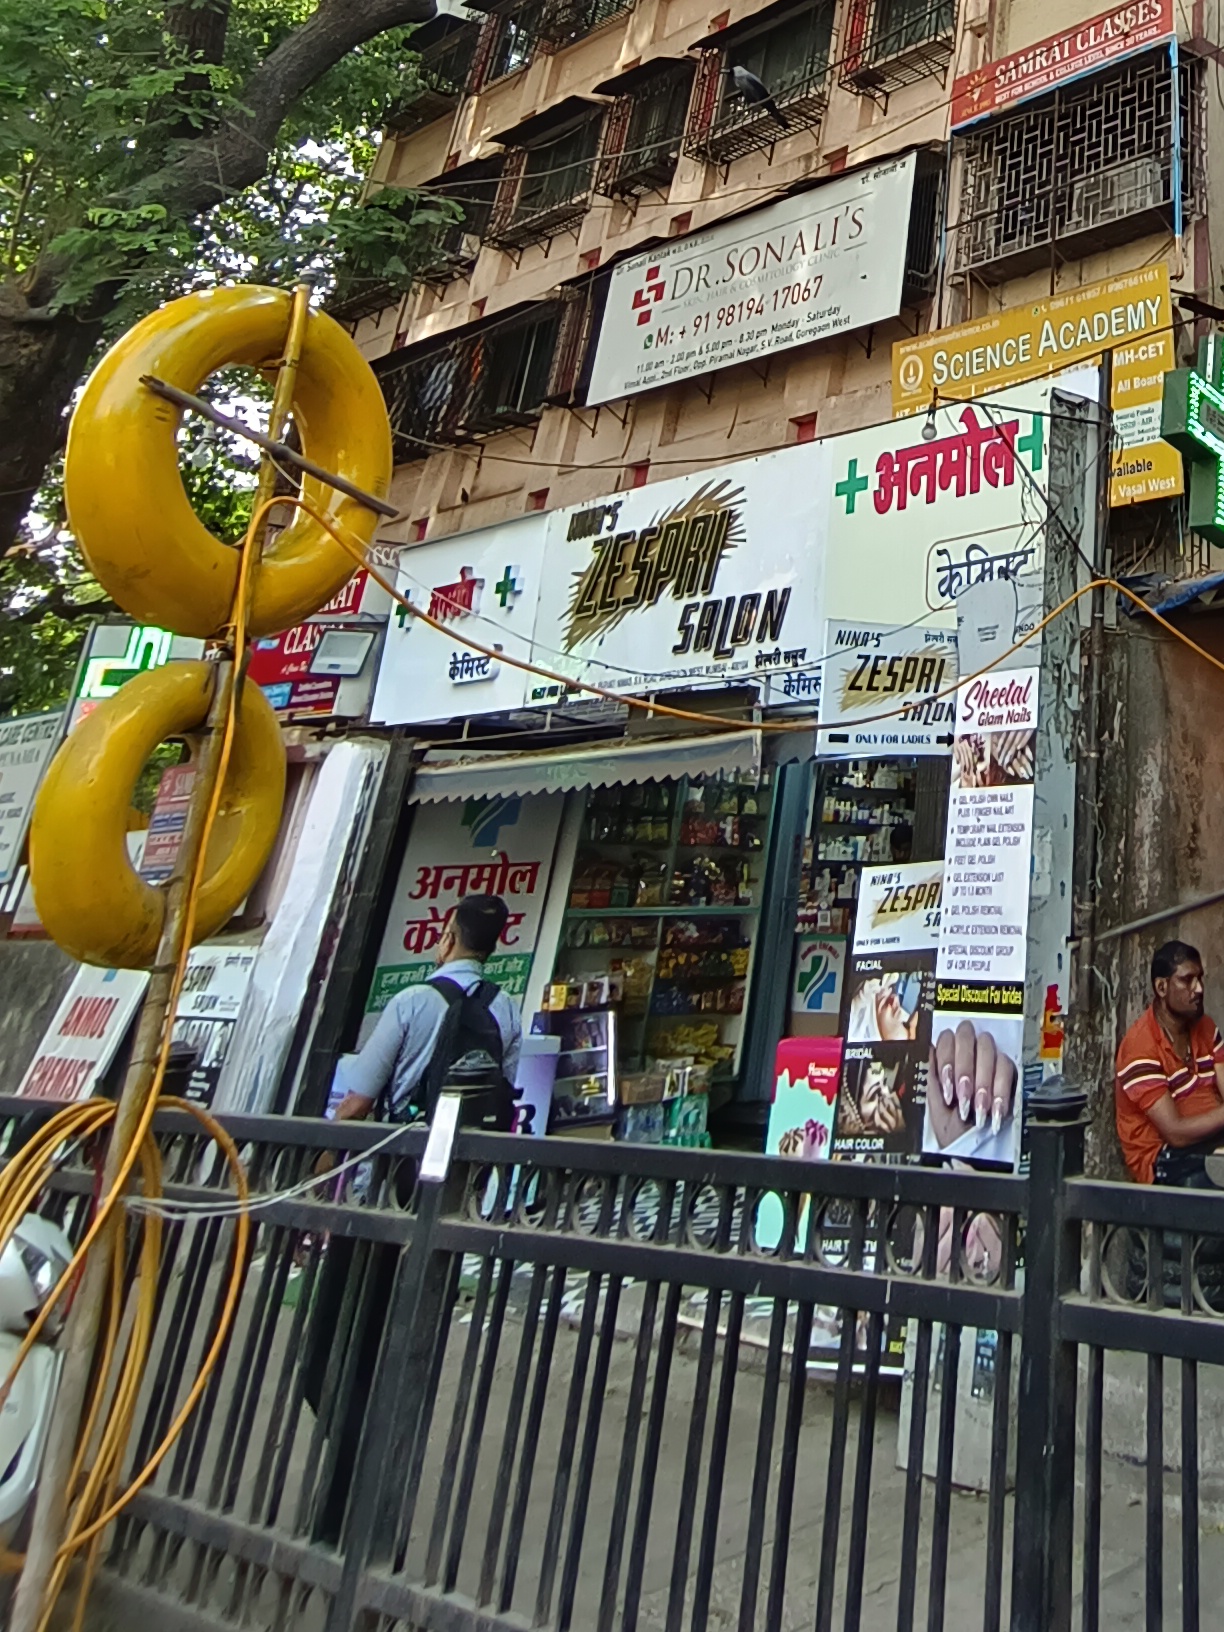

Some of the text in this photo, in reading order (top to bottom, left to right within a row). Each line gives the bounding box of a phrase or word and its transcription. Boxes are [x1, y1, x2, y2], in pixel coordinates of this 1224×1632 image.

[995, 35, 1075, 89] SAMRAT
[693, 311, 710, 337] 91
[717, 293, 765, 330] 98194
[772, 273, 824, 312] 17067
[771, 317, 800, 334] Monday
[806, 305, 842, 323] Saturday
[832, 314, 851, 328] West
[932, 332, 1031, 386] SCIENCE
[1038, 295, 1162, 358] ACADEMY
[1114, 340, 1166, 367] MH-CET
[1117, 378, 1131, 394] All
[873, 406, 1019, 515] अनमोल
[1110, 458, 1153, 478] vailable
[1148, 476, 1176, 491] West
[575, 508, 732, 618] ZESPRI
[672, 587, 792, 660] SALON
[835, 628, 882, 648] NINA'S
[848, 652, 945, 694] ZESPRI
[962, 675, 1033, 722] Sheetal
[897, 698, 957, 726] SALON
[977, 706, 1031, 727] Glam Nails
[855, 733, 931, 745] ONLY FOR LADIES
[408, 851, 542, 900] अनमोल
[870, 872, 902, 887] NINA'S
[856, 959, 883, 972] FACIAL
[937, 983, 960, 1006] Special
[961, 984, 989, 1004] Discount
[989, 985, 1001, 1004] For
[1001, 986, 1023, 1005] brides
[845, 1047, 874, 1060] BRIDAL
[834, 1138, 884, 1150] HAIR COLOR
[822, 1239, 842, 1253] HAIR
